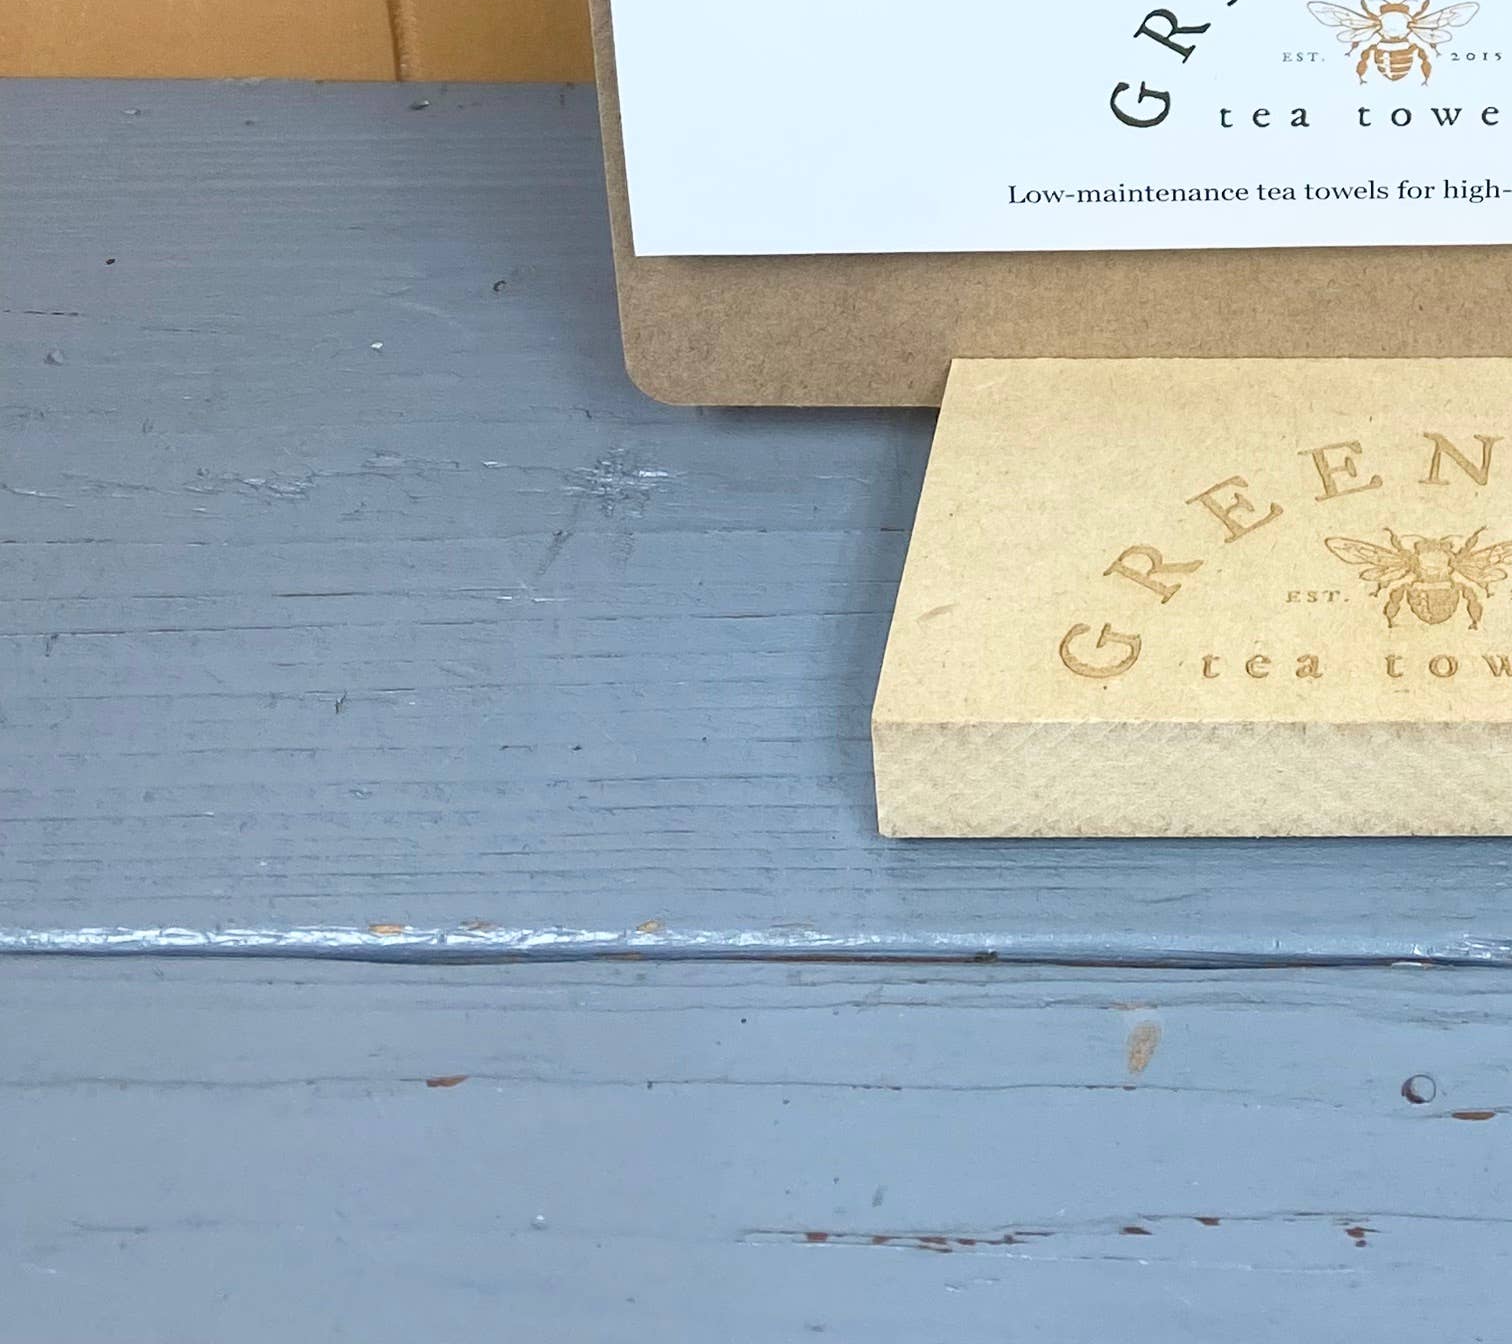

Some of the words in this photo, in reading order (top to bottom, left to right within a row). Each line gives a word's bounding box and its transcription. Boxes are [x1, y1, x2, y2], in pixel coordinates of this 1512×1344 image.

[1281, 51, 1326, 63] EST.
[1450, 51, 1503, 62] 2015
[1219, 106, 1311, 129] tea
[1008, 183, 1249, 204] Low-maintenance
[1256, 183, 1297, 201] tea
[1304, 179, 1389, 201] towels
[1396, 179, 1436, 200] for
[1058, 431, 1505, 679] GREEN
[1285, 590, 1350, 604] EST.
[1201, 653, 1324, 679] tea
